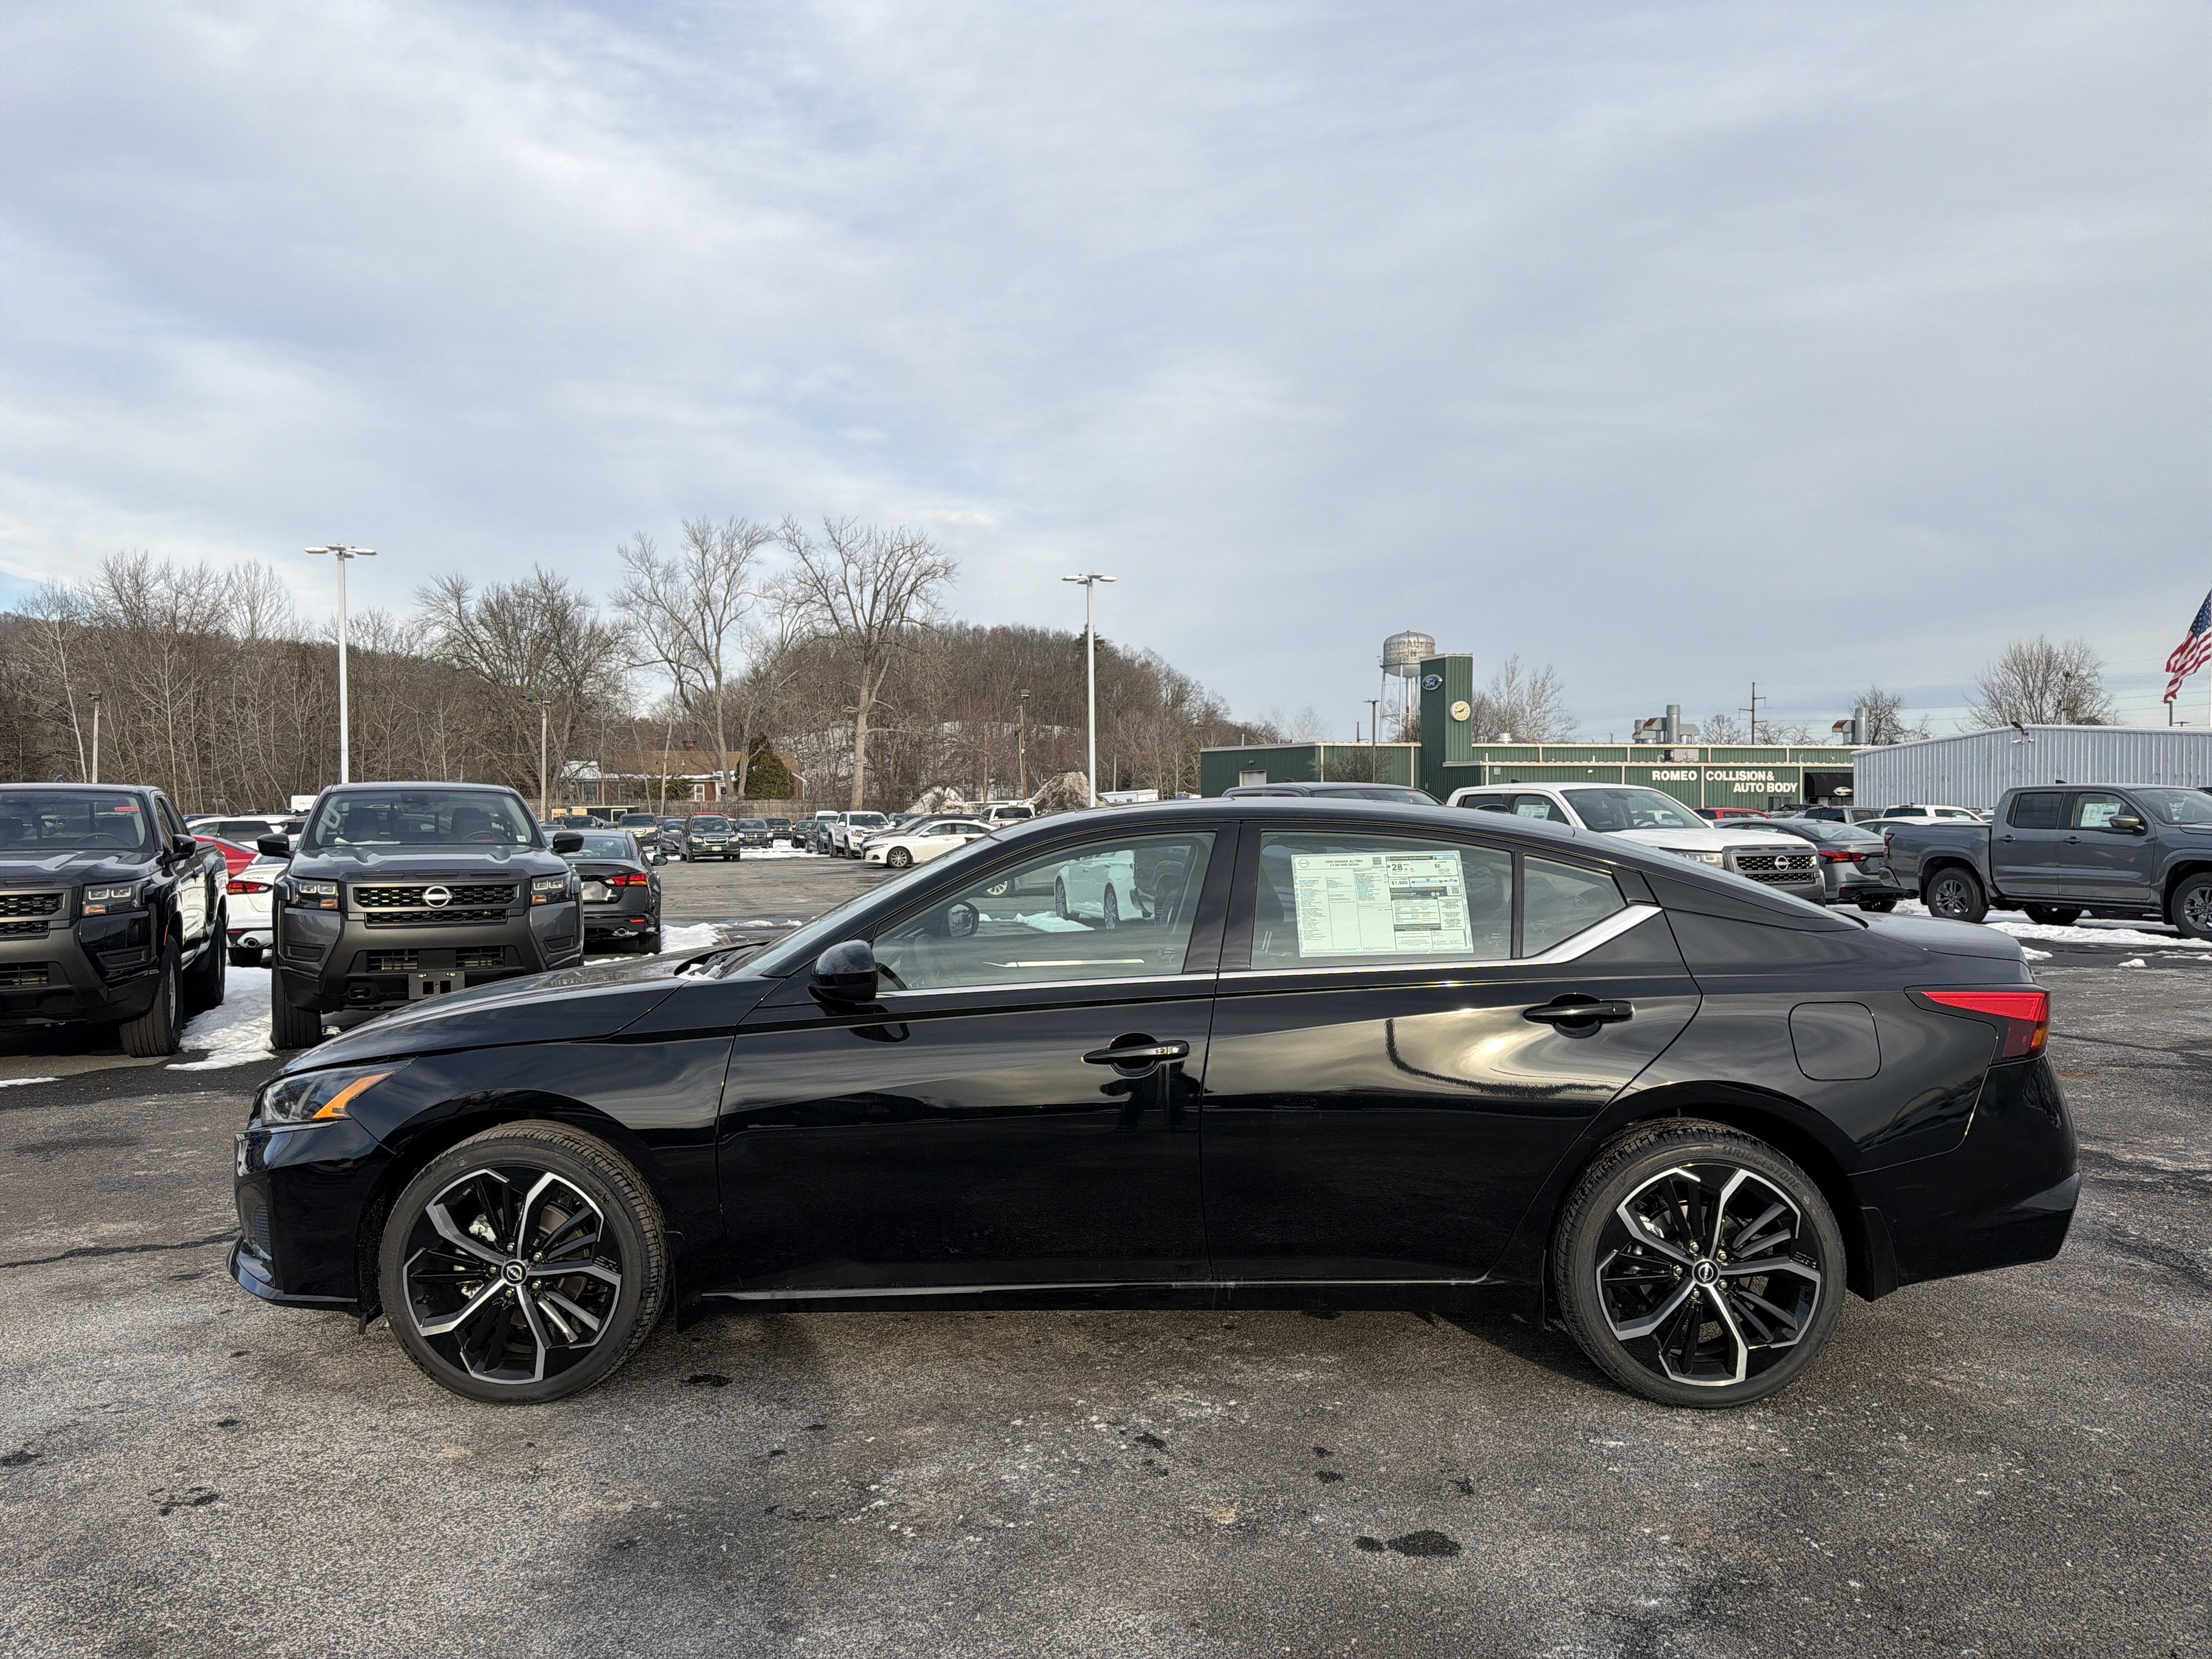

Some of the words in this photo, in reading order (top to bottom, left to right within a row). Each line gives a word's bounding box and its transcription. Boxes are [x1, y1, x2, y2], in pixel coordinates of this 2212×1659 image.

[1652, 770, 1697, 781] ROMEO
[1733, 782, 1765, 793] AUTO
[1767, 782, 1798, 793] BODY
[1722, 1146, 1802, 1190] BRIDGESTONE
